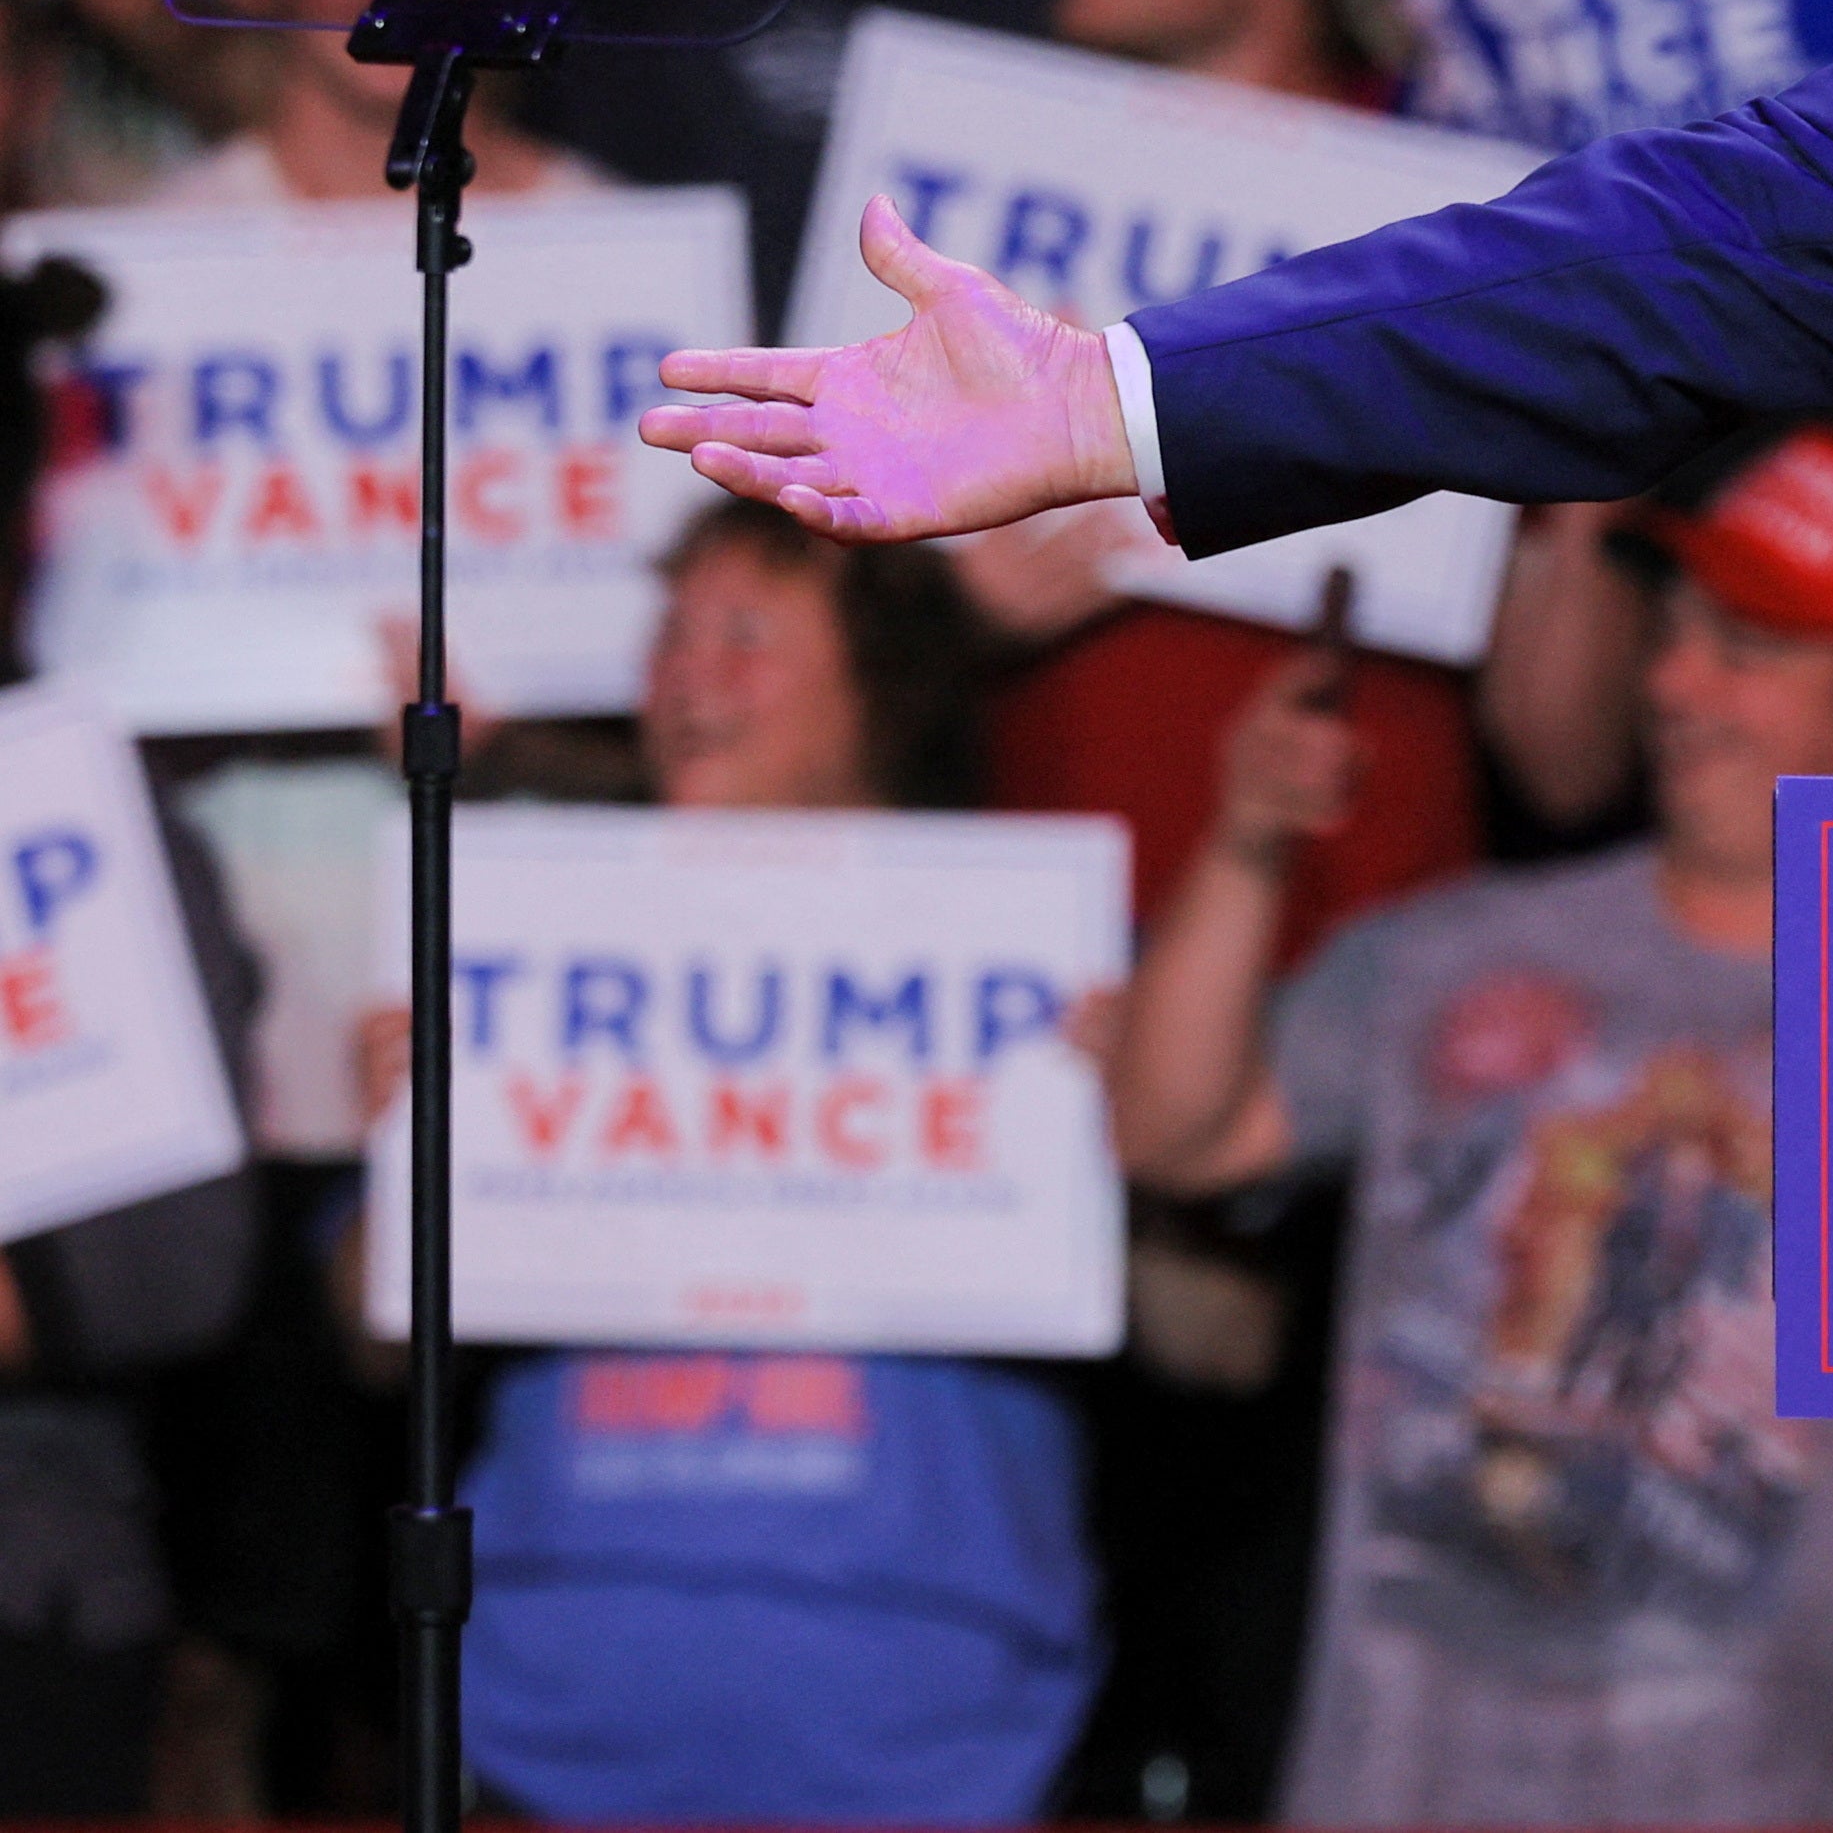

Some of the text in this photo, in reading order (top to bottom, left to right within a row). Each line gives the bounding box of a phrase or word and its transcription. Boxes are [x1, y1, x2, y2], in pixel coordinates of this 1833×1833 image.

[84, 328, 678, 452] TRUMP
[143, 446, 632, 546] VANCE
[452, 953, 1062, 1064] TRUMP
[505, 1068, 990, 1166] VANCE
